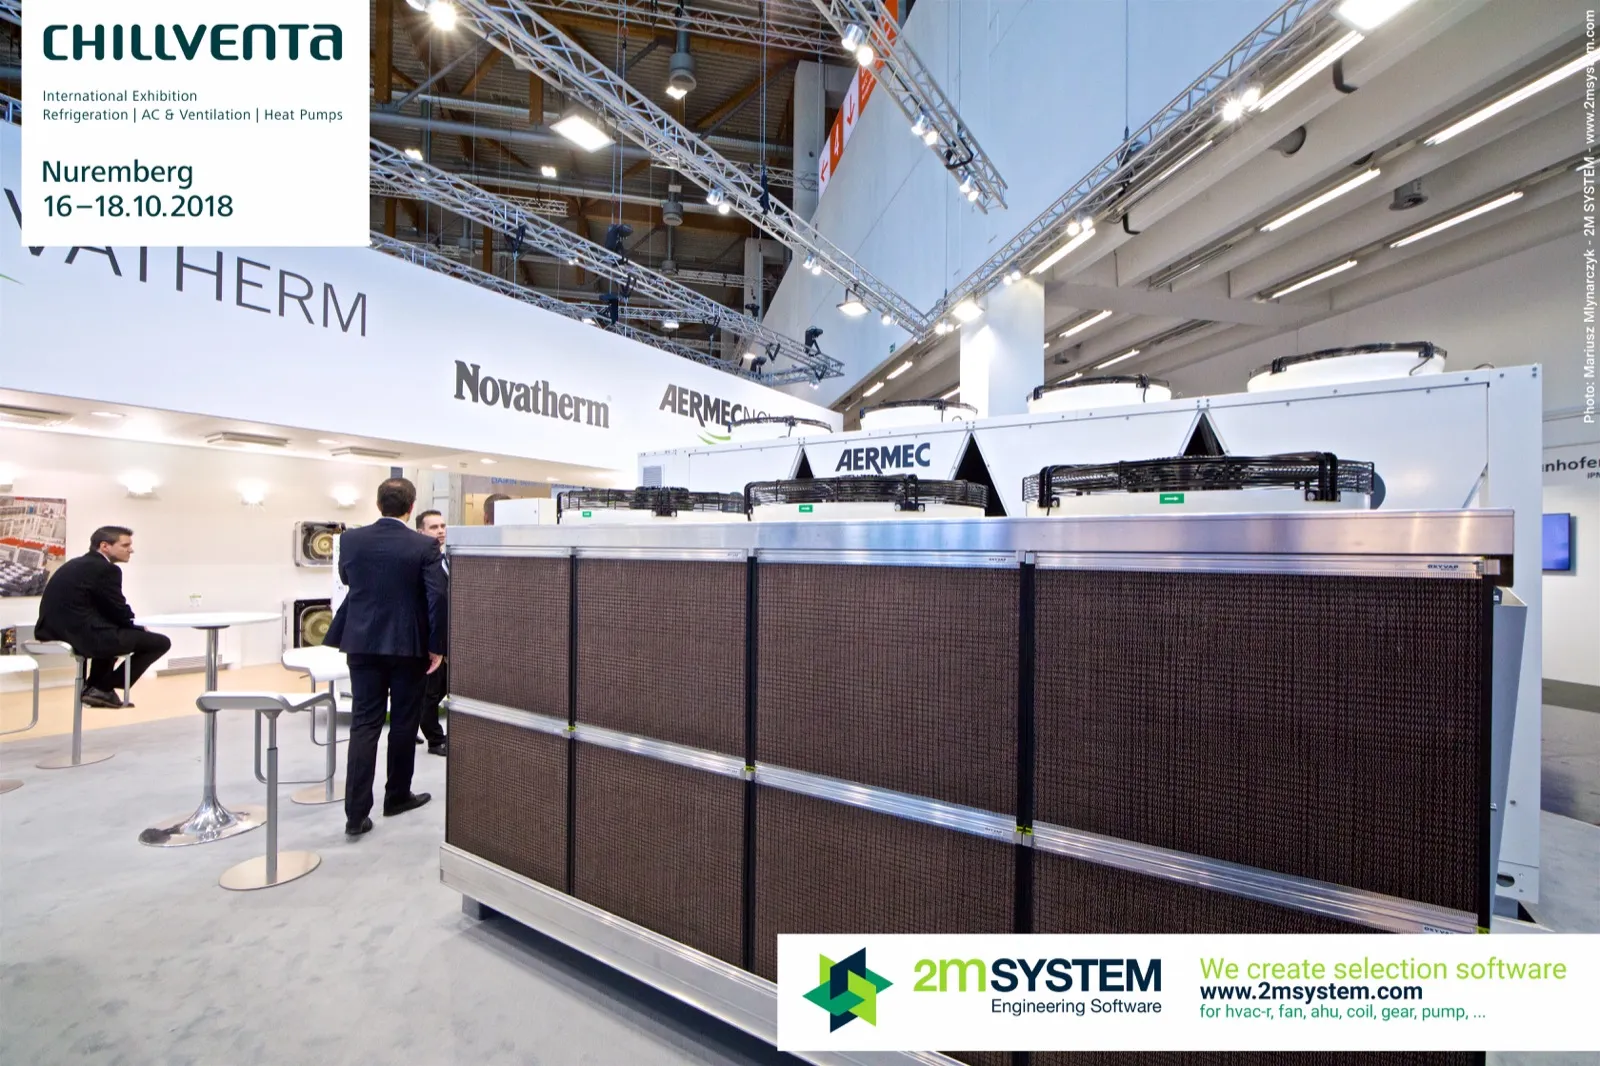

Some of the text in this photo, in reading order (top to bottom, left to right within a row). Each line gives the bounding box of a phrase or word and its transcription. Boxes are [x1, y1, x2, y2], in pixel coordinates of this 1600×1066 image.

[453, 360, 610, 429] Novatherm
[835, 442, 931, 474] AERMEC
[1542, 456, 1600, 472] nhofe
